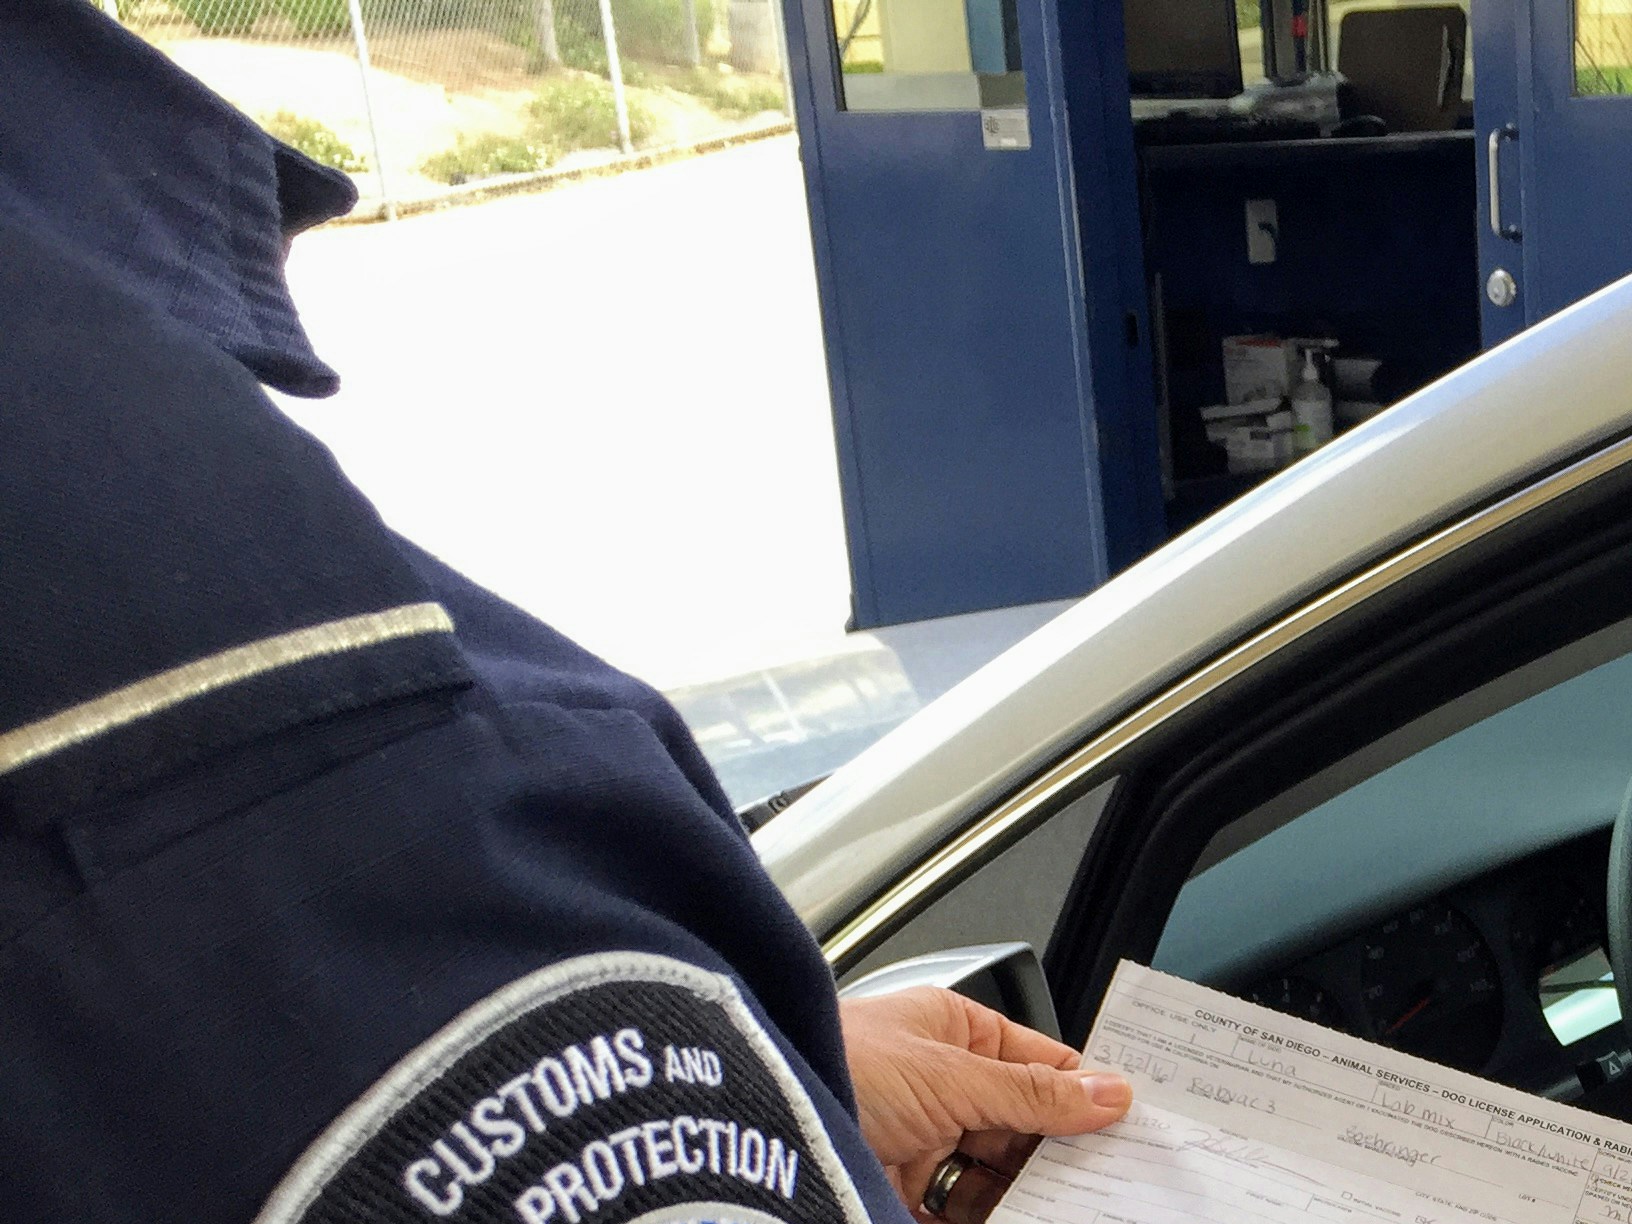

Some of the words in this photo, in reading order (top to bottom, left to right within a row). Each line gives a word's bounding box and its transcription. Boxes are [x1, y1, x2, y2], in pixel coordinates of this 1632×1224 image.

[403, 1027, 653, 1217] CUSTOMS
[664, 1044, 723, 1087] AND
[1192, 1008, 1242, 1031] COUNTY
[1241, 1025, 1259, 1037] OF
[1258, 1030, 1285, 1045] SAN
[1284, 1039, 1322, 1058] DIEGO
[1331, 1054, 1375, 1075] ANIMAL
[1374, 1068, 1431, 1093] SERVICES
[1440, 1089, 1466, 1104] DOG
[1467, 1097, 1516, 1120] LICENSE
[1516, 1112, 1591, 1144] APPLICATION
